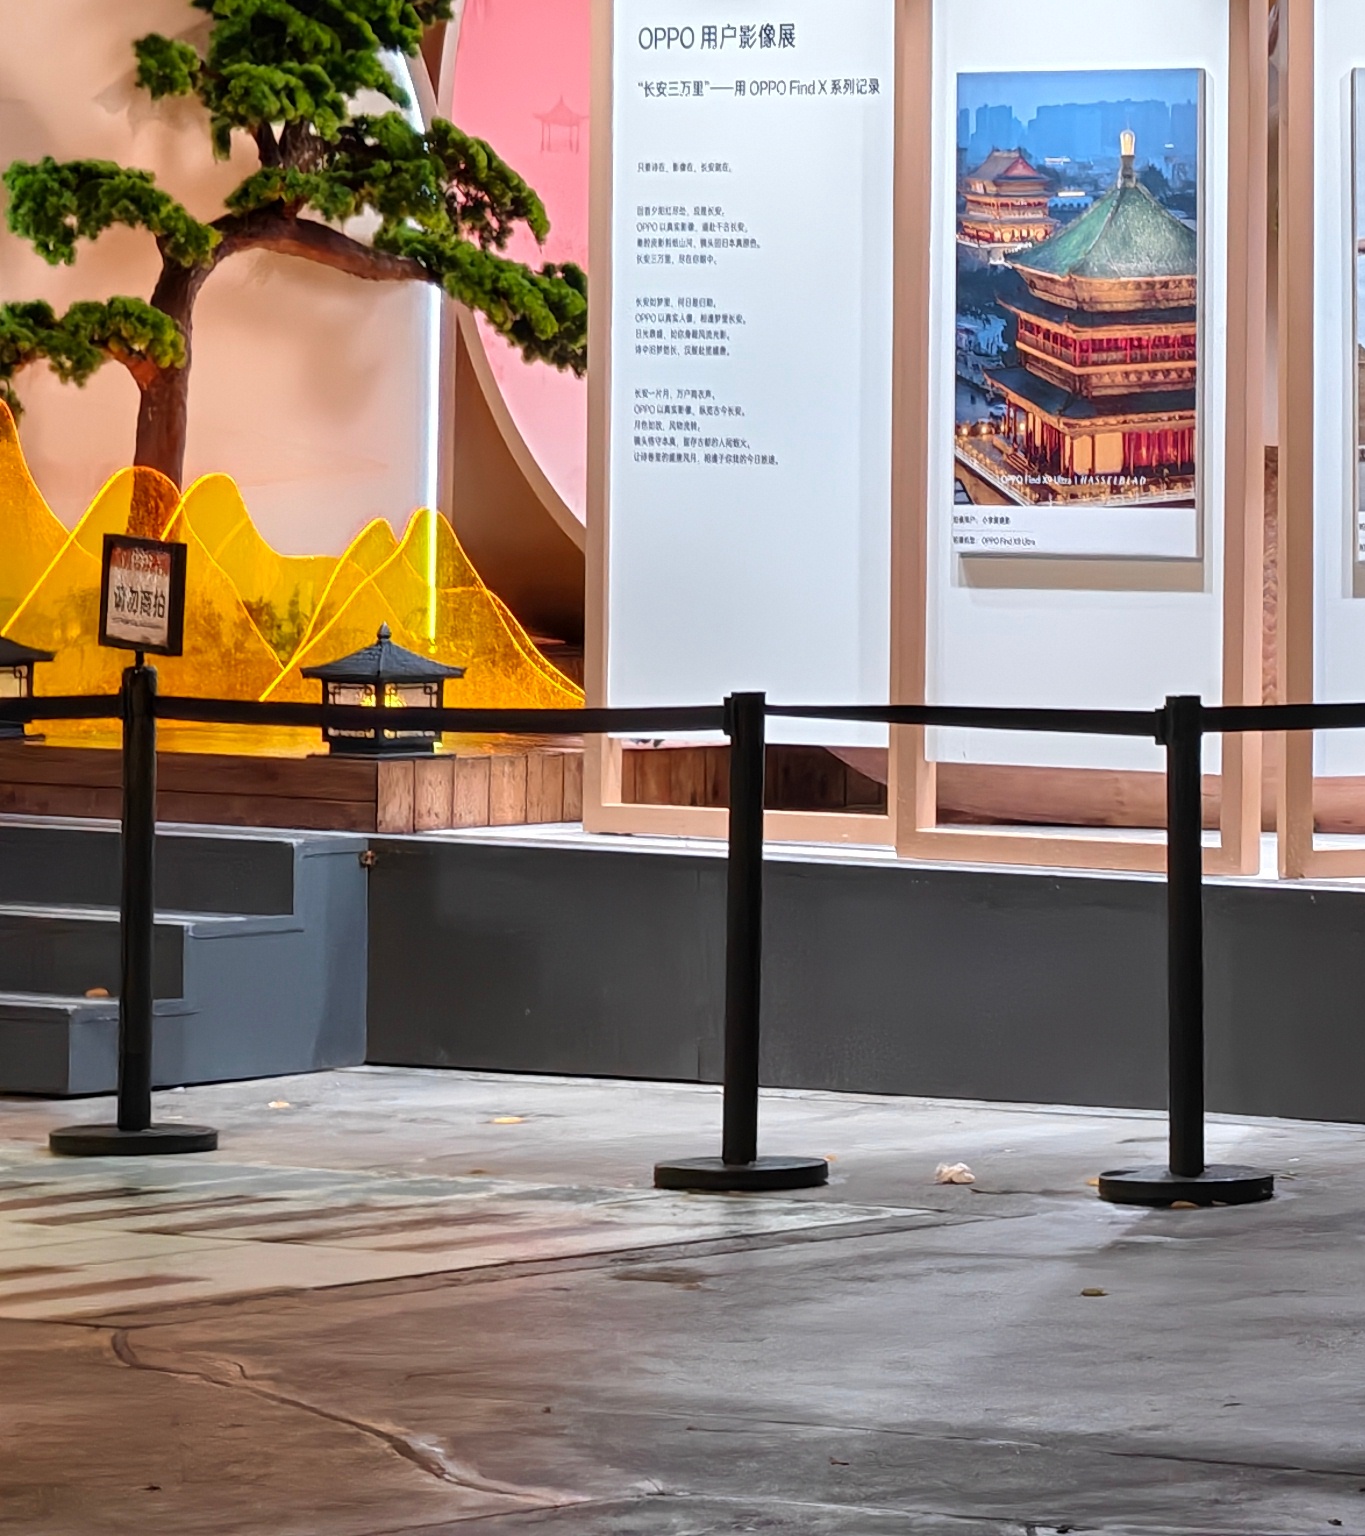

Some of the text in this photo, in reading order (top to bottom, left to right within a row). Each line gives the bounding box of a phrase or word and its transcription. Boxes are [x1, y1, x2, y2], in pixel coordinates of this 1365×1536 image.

[638, 22, 797, 51] OPPO 用户影像展
[749, 80, 786, 97] OPPO
[789, 79, 815, 96] Find
[817, 79, 828, 96] X
[830, 77, 881, 96] 系列记录
